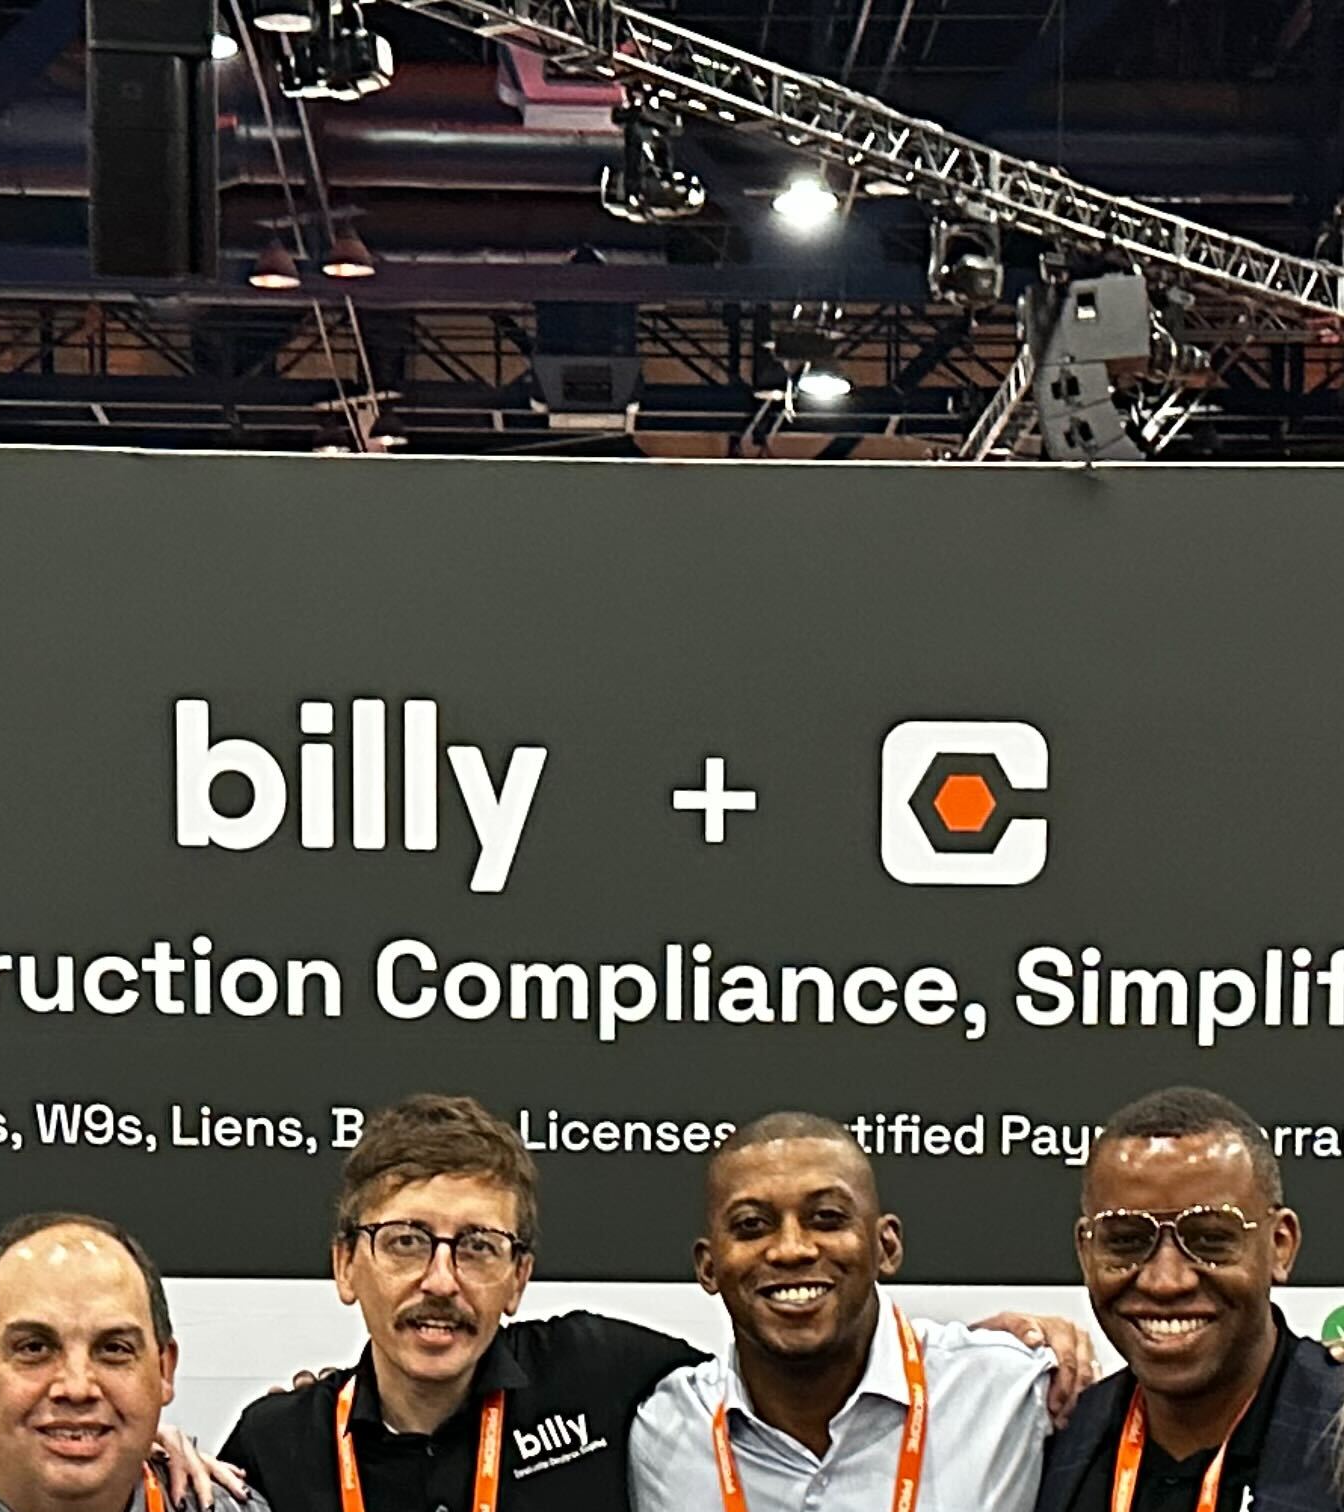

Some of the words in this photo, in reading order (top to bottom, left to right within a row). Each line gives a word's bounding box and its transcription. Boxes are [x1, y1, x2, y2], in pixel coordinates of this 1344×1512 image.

[176, 699, 547, 892] billy
[377, 940, 985, 1040] Compliance,
[35, 1103, 158, 1152] W9s,
[171, 1105, 317, 1154] Liens,
[844, 1113, 983, 1156] tified
[513, 1413, 588, 1460] billy
